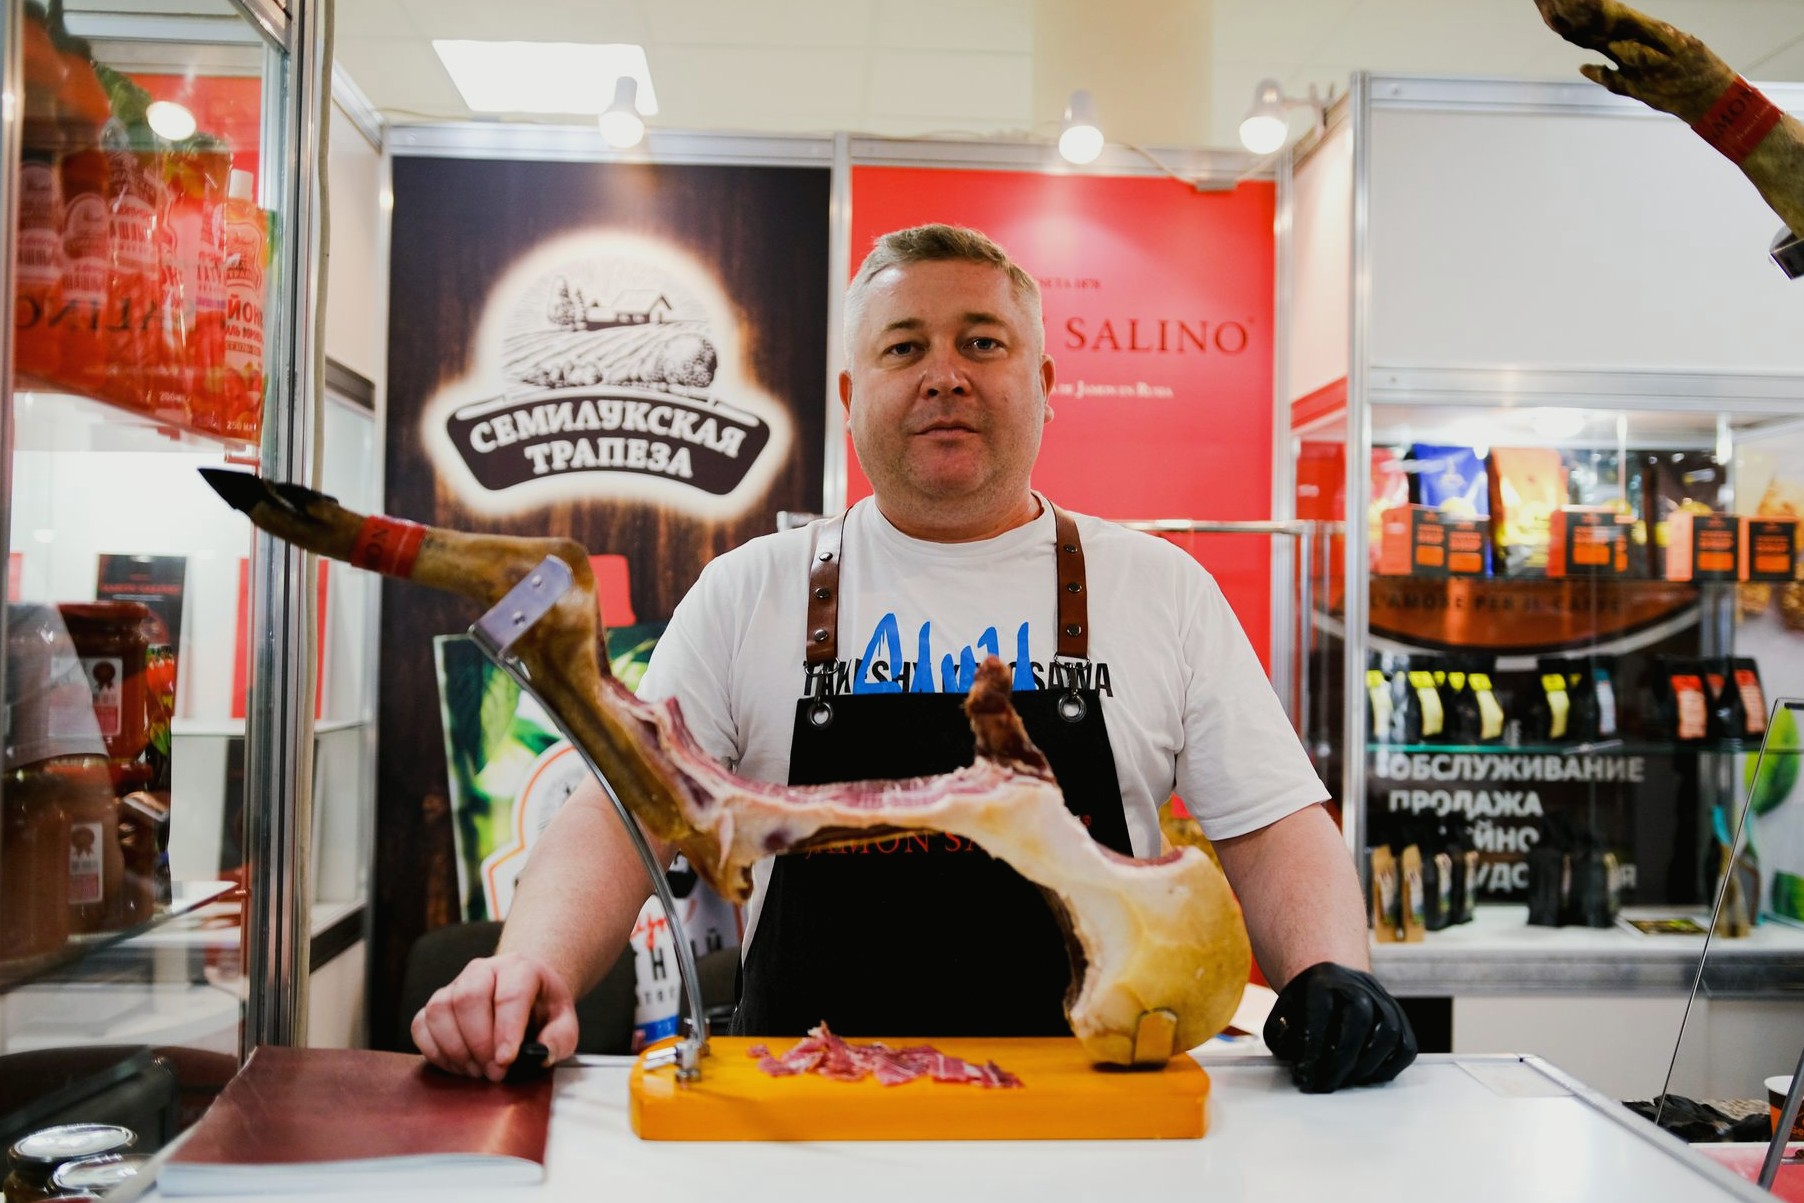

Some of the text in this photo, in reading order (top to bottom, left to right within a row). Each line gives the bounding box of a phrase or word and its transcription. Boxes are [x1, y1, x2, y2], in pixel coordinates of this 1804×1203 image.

[1065, 317, 1249, 356] SALINO
[469, 399, 748, 459] СЕМИЛУКСКАЯ
[524, 436, 694, 480] ТРАПЕЗА
[1390, 752, 1645, 782] ОБСЛУЖИВАНИЕ
